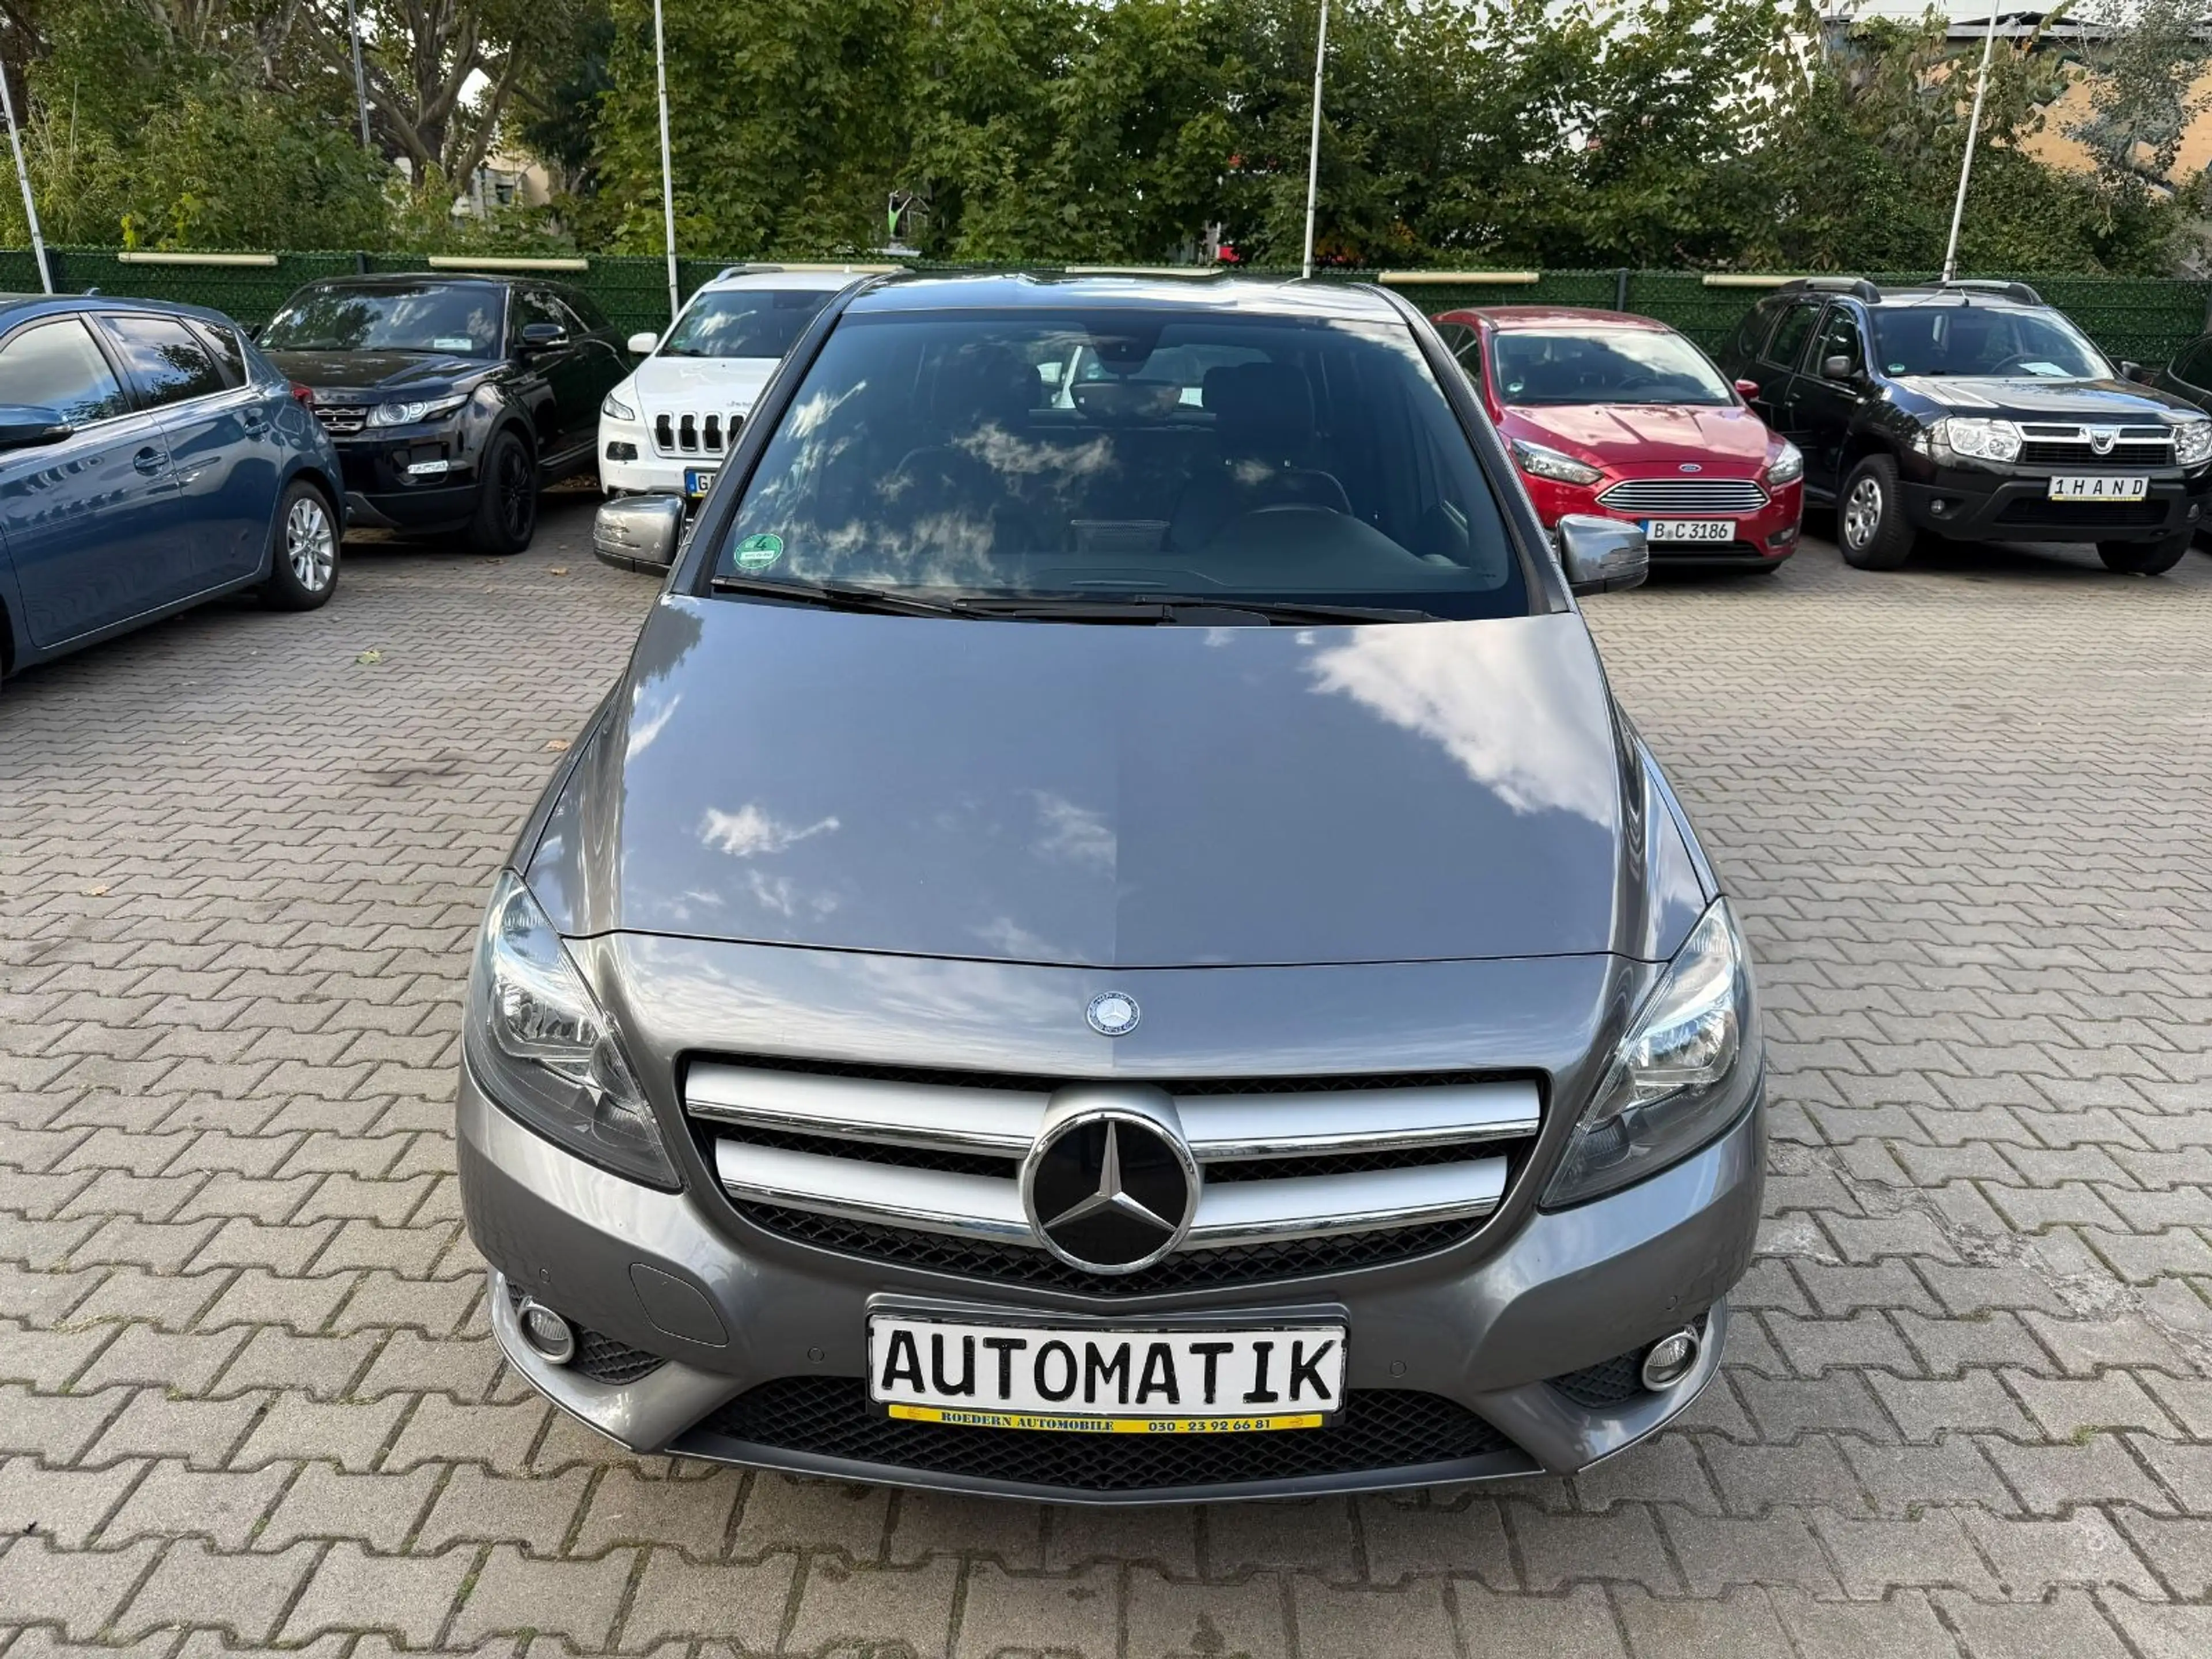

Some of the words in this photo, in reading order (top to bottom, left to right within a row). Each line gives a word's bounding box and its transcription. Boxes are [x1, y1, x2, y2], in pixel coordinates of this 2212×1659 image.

[1655, 523, 1664, 538] B
[1675, 524, 1685, 538] C
[1689, 524, 1728, 539] 3186
[753, 536, 767, 551] 4
[881, 1330, 1336, 1404] AUTOMATIK
[941, 1411, 1012, 1426] ROEDERN
[1017, 1417, 1115, 1431] AUTOMOBILE
[1149, 1422, 1175, 1431] 030
[1188, 1421, 1206, 1430] 23
[1211, 1421, 1229, 1430] 92
[1233, 1421, 1251, 1430] 66
[1255, 1419, 1270, 1429] 81
